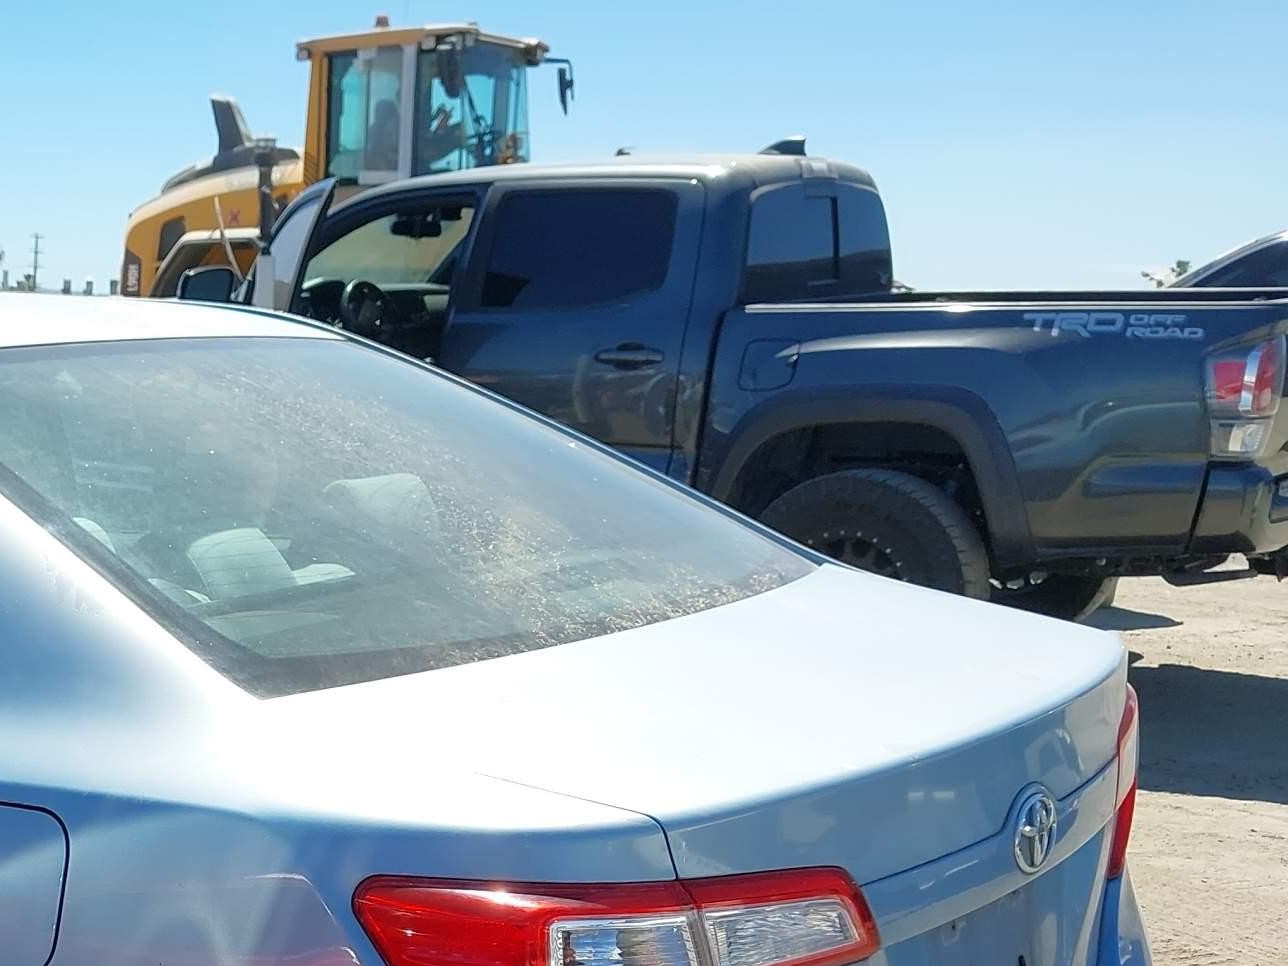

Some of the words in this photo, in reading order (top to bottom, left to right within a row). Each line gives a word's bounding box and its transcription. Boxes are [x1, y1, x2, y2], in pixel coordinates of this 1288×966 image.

[1023, 312, 1125, 337] TRD
[1129, 314, 1187, 325] OFF
[1125, 327, 1205, 338] ROAD
